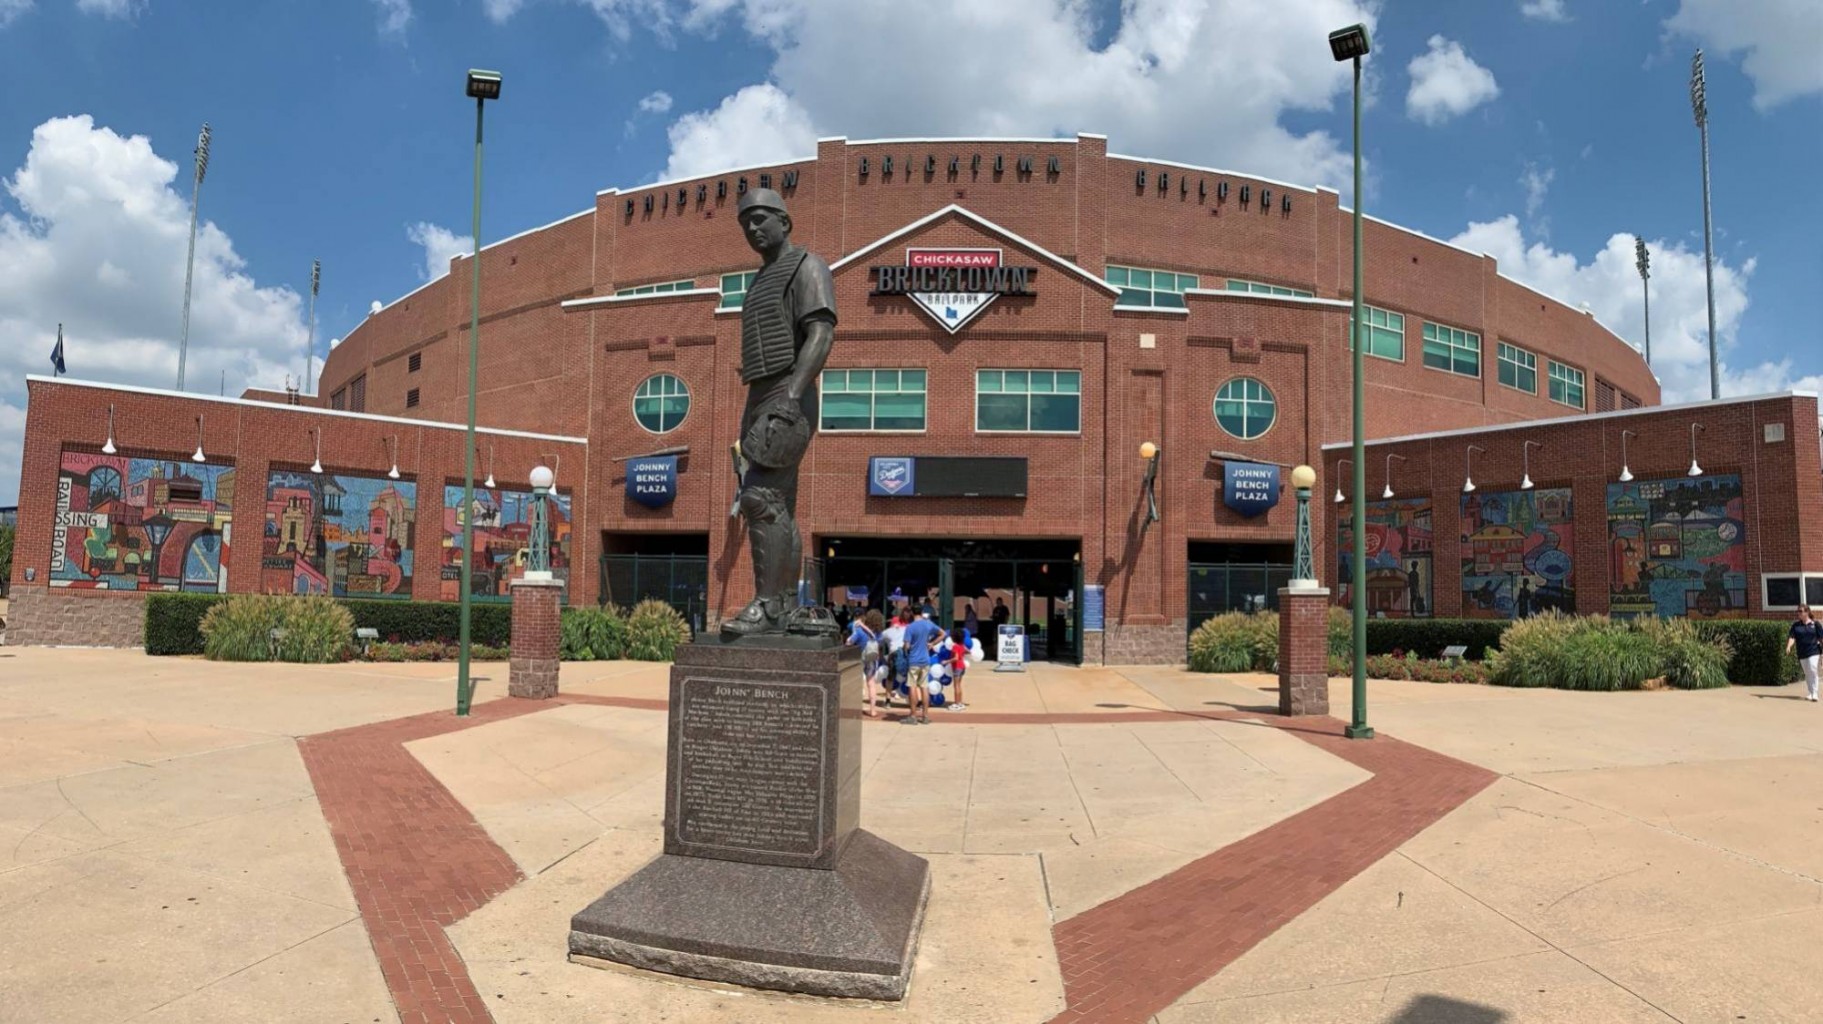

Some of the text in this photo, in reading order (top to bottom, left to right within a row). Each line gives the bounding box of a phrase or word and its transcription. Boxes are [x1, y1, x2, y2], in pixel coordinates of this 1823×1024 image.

[859, 153, 1061, 175] BRICKTOWN
[914, 255, 994, 265] CHICKASAW
[878, 266, 1029, 292] BRICKTOWN
[927, 294, 980, 305] BALLPARK
[636, 474, 667, 483] BENCH
[1232, 469, 1272, 478] JOHNNY
[636, 485, 667, 493] PLAZA
[1235, 480, 1270, 489] BENCH
[1235, 491, 1268, 501] PLAZA
[754, 688, 789, 700] BENCH
